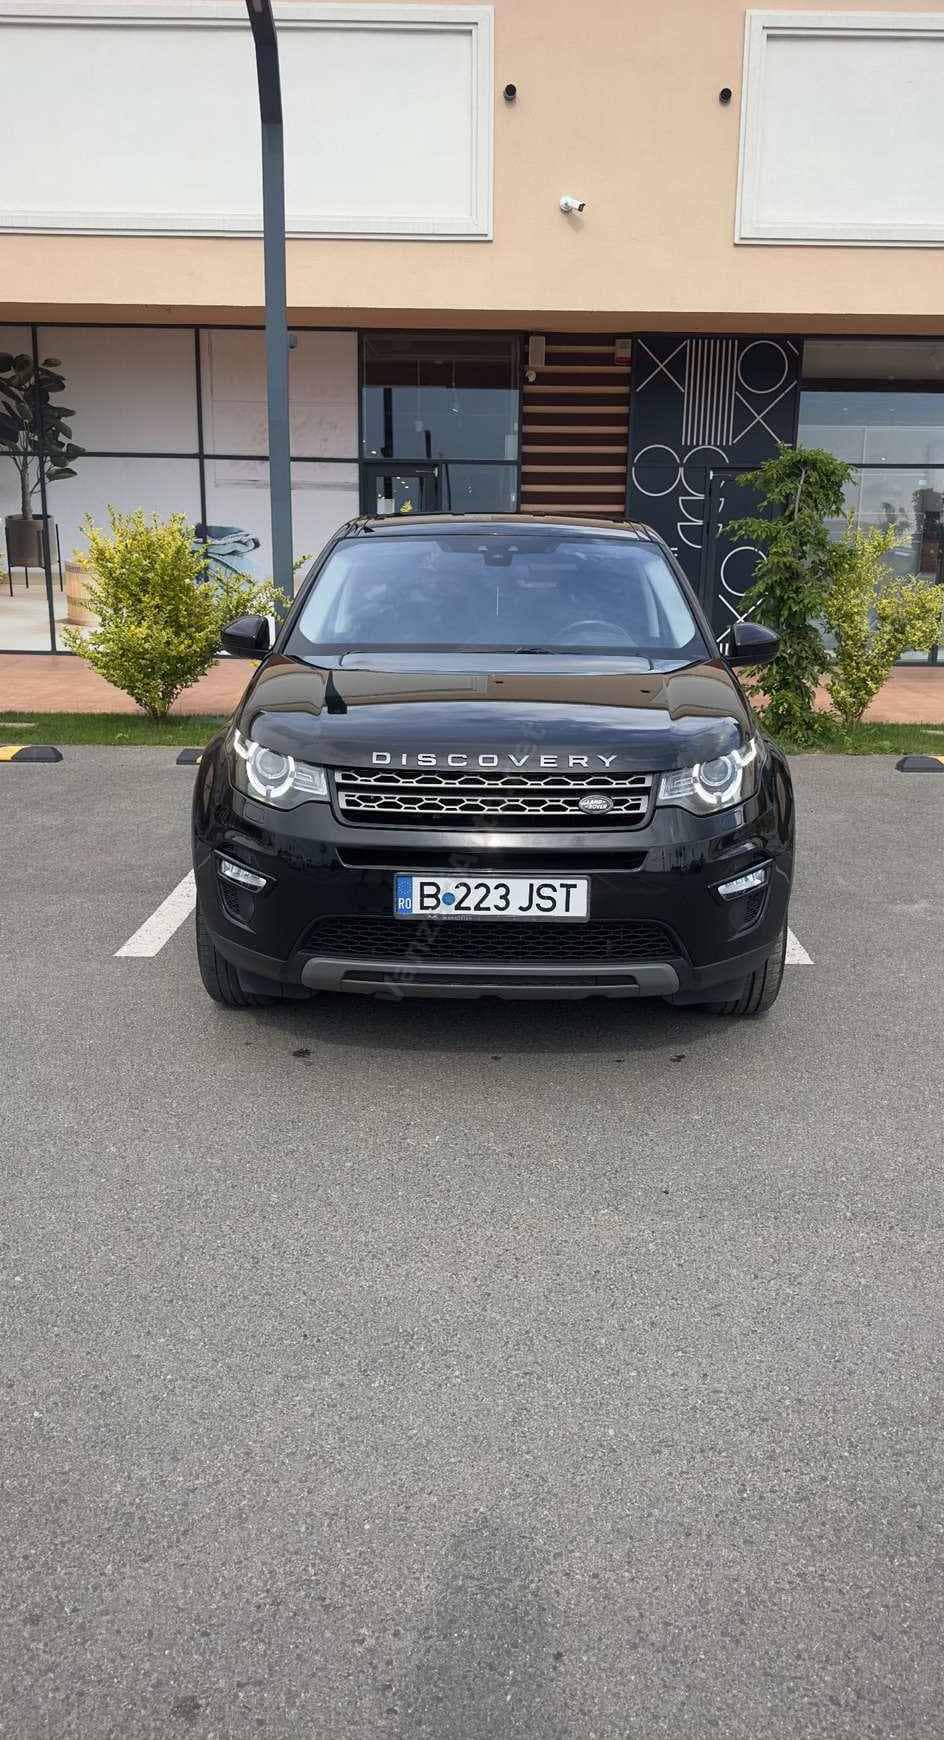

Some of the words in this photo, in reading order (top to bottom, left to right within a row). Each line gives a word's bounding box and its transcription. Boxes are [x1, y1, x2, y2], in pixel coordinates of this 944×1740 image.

[371, 751, 618, 768] DISCOVERY
[398, 897, 412, 910] RO
[419, 881, 441, 911] B
[454, 882, 510, 912] 223
[518, 883, 577, 912] JST
